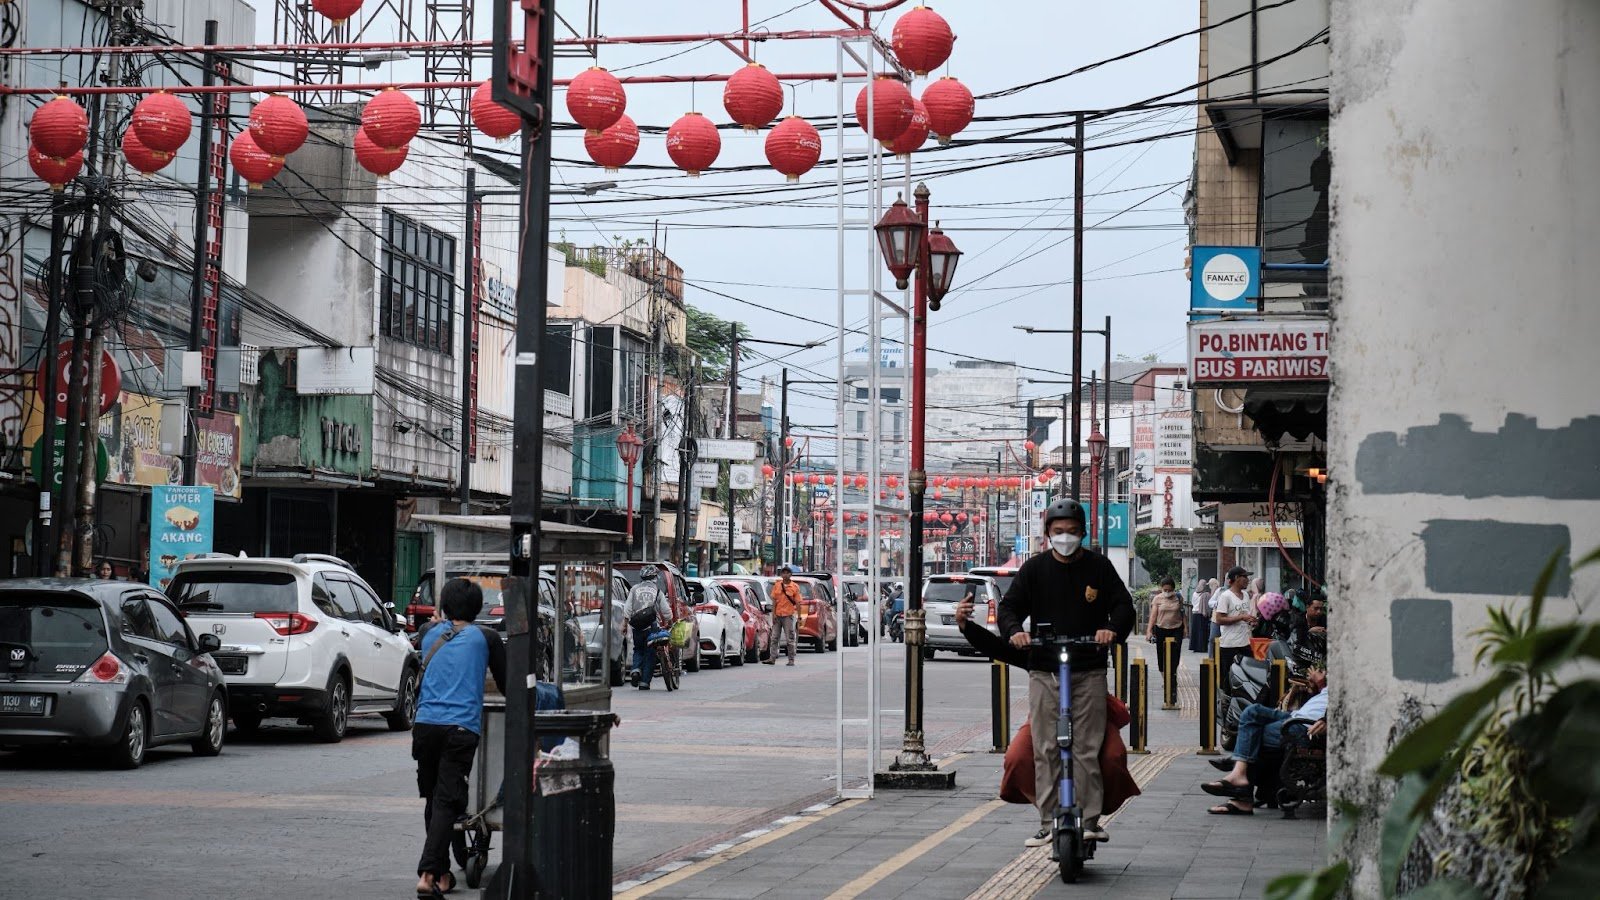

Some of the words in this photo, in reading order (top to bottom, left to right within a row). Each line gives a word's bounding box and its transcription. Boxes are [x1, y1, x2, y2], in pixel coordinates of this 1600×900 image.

[1197, 360, 1236, 377] BUS
[165, 494, 201, 503] LUMER
[160, 532, 202, 543] AKANG
